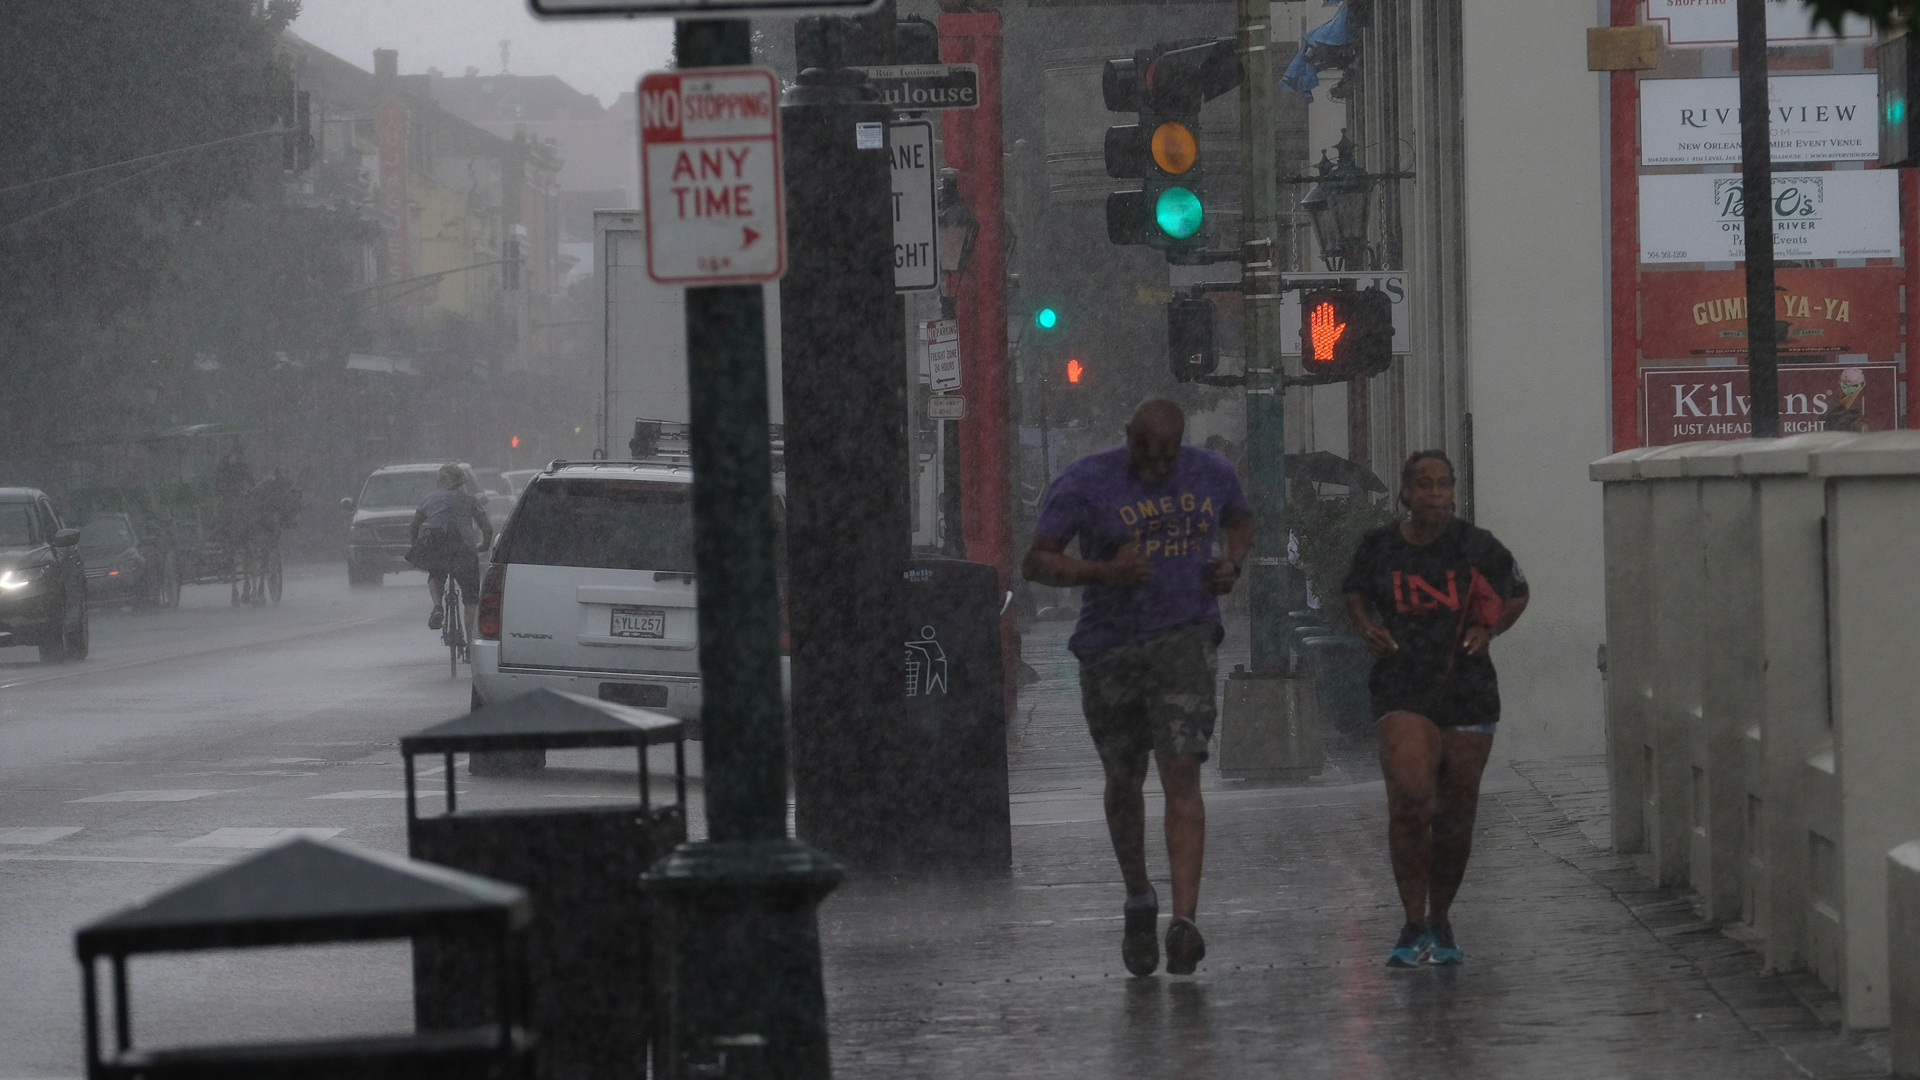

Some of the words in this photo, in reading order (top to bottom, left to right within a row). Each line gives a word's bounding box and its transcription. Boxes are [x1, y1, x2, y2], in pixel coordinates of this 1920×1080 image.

[875, 69, 894, 77] Rue
[899, 68, 941, 76] Toulouse
[884, 81, 974, 104] ulouse
[643, 88, 680, 130] NO
[684, 92, 769, 121] STOPPING
[1680, 105, 1857, 128] RIVVIEW
[671, 146, 749, 181] ANY
[889, 144, 924, 169] ANE
[671, 184, 755, 219] TIME
[1722, 223, 1740, 231] ON
[1778, 221, 1815, 230] RIVER
[1773, 233, 1808, 244] Events
[894, 242, 929, 268] GHT
[1692, 296, 1747, 326] GUM
[1783, 294, 1850, 323] YA-YA
[927, 327, 936, 341] NO
[936, 325, 957, 338] PARKING
[930, 350, 946, 362] FREIGHT
[946, 349, 957, 359] ZONE
[934, 364, 940, 373] 24
[941, 361, 954, 372] HOURS
[1671, 381, 1828, 417] Kilns
[1673, 424, 1704, 438] JUST
[1706, 422, 1752, 435] AHEAD
[1784, 420, 1826, 433] RIGHT
[1119, 493, 1214, 526] OMEGA
[1148, 516, 1191, 536] PSI
[1146, 538, 1188, 557] PHI
[903, 569, 932, 579] gBelly
[621, 617, 661, 631] YLL257
[510, 632, 553, 640] YUKON
